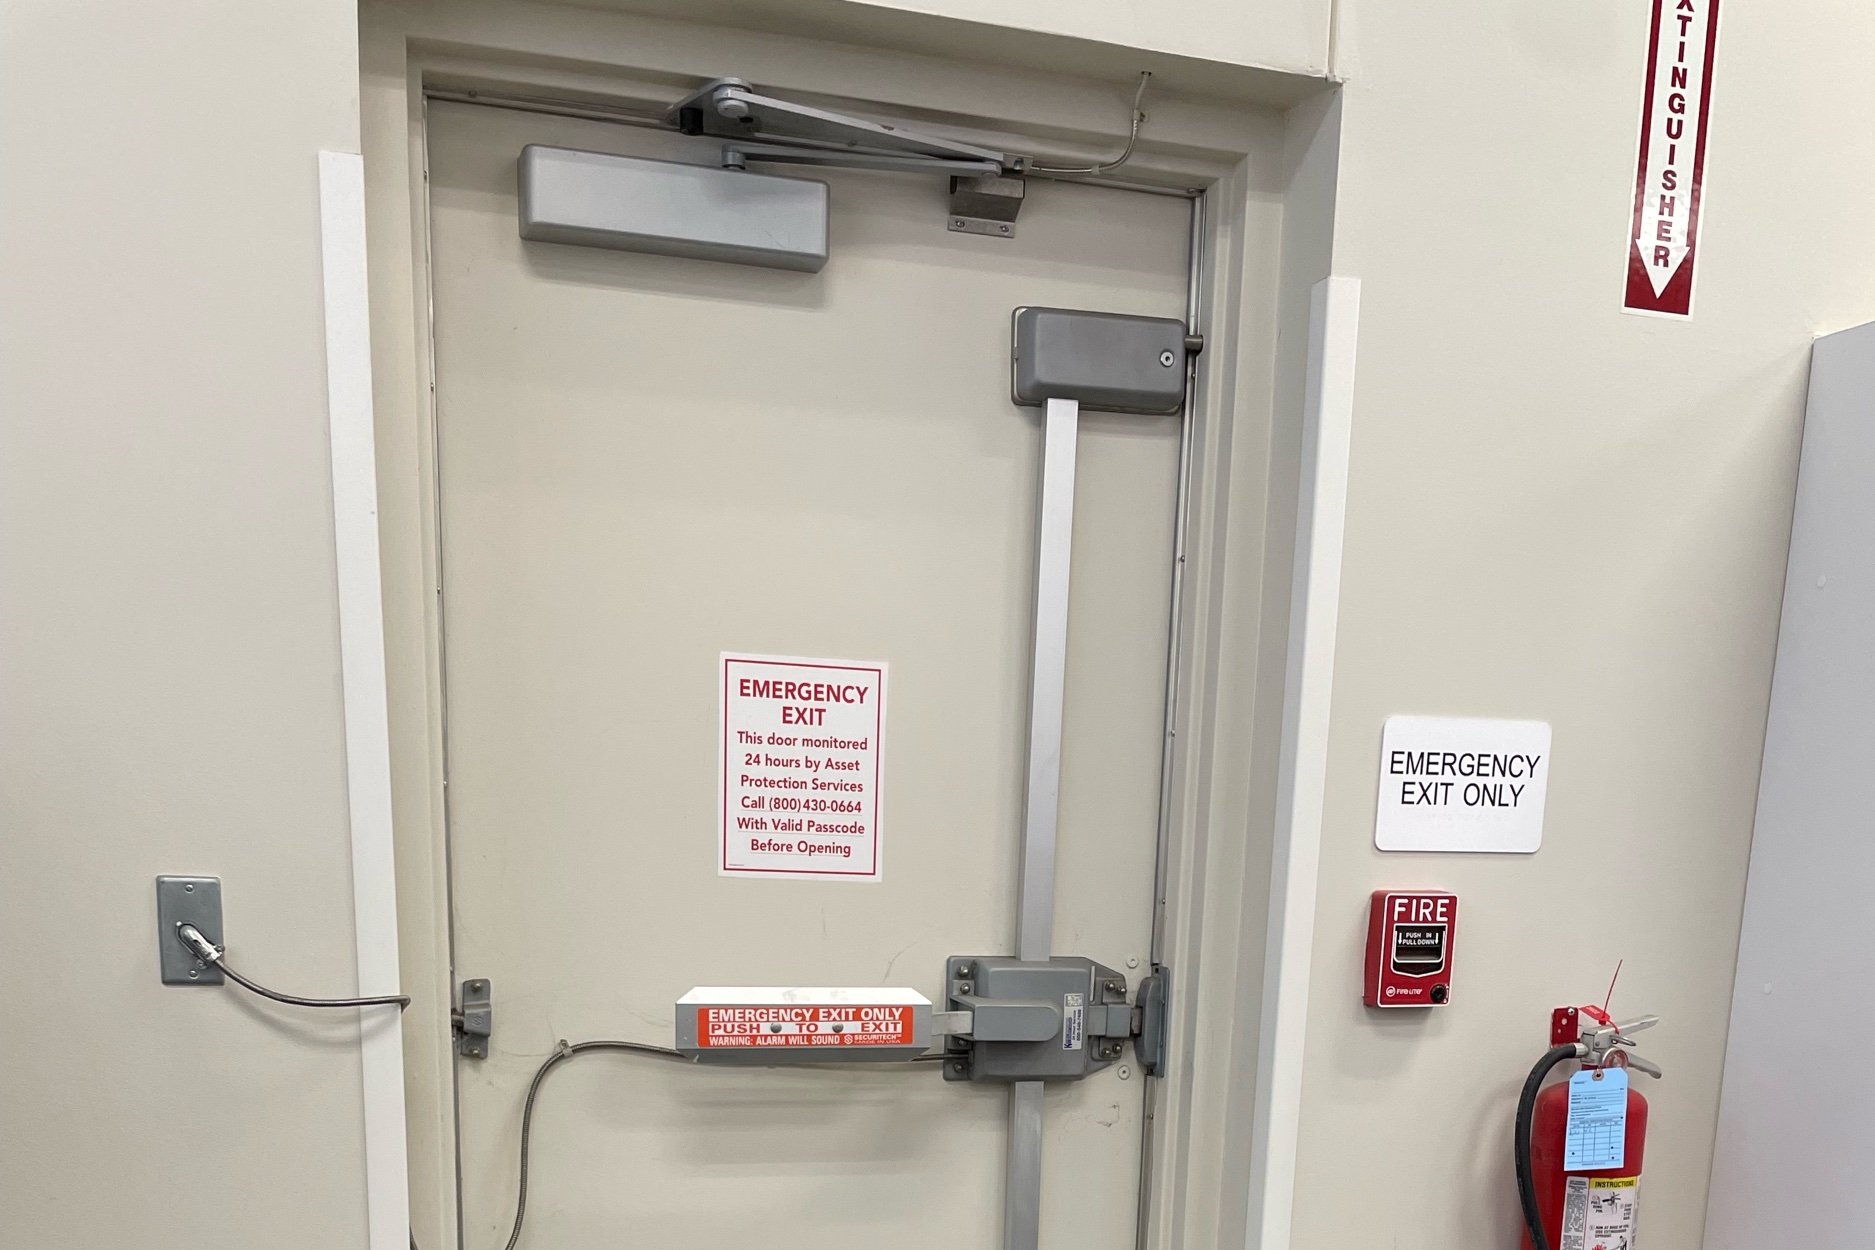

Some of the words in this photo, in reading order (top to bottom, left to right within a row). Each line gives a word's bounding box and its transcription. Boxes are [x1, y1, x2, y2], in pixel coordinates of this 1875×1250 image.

[739, 678, 869, 704] EMERGENCY
[781, 706, 827, 726] EXIT
[737, 731, 763, 745] This
[767, 732, 798, 747] door
[801, 736, 868, 750] monitored
[744, 753, 761, 766] 24
[765, 754, 801, 769] hours
[805, 756, 821, 772] by
[824, 757, 860, 771] Asset
[1389, 751, 1541, 778] EMERGENCY
[740, 775, 807, 790] Protection
[811, 778, 863, 792] Services
[741, 795, 765, 809] Call
[1400, 781, 1454, 805] EXIT
[1463, 783, 1525, 807] ONLY
[737, 817, 768, 830] With
[771, 818, 803, 832] Valid
[807, 820, 865, 834] Passcode
[751, 839, 793, 852] Before
[797, 840, 851, 857] Opening
[1393, 898, 1450, 922] FIRE
[708, 1007, 813, 1022] EMERGENCY
[818, 1008, 856, 1021] EXIT
[860, 1007, 903, 1021] ONLY
[710, 1023, 761, 1034] PUSH
[795, 1022, 819, 1033] TO
[860, 1021, 901, 1032] EXIT
[709, 1036, 754, 1046] WARNING:
[755, 1036, 786, 1046] ALARM
[788, 1035, 809, 1045] WILL
[811, 1035, 840, 1045] SOUND
